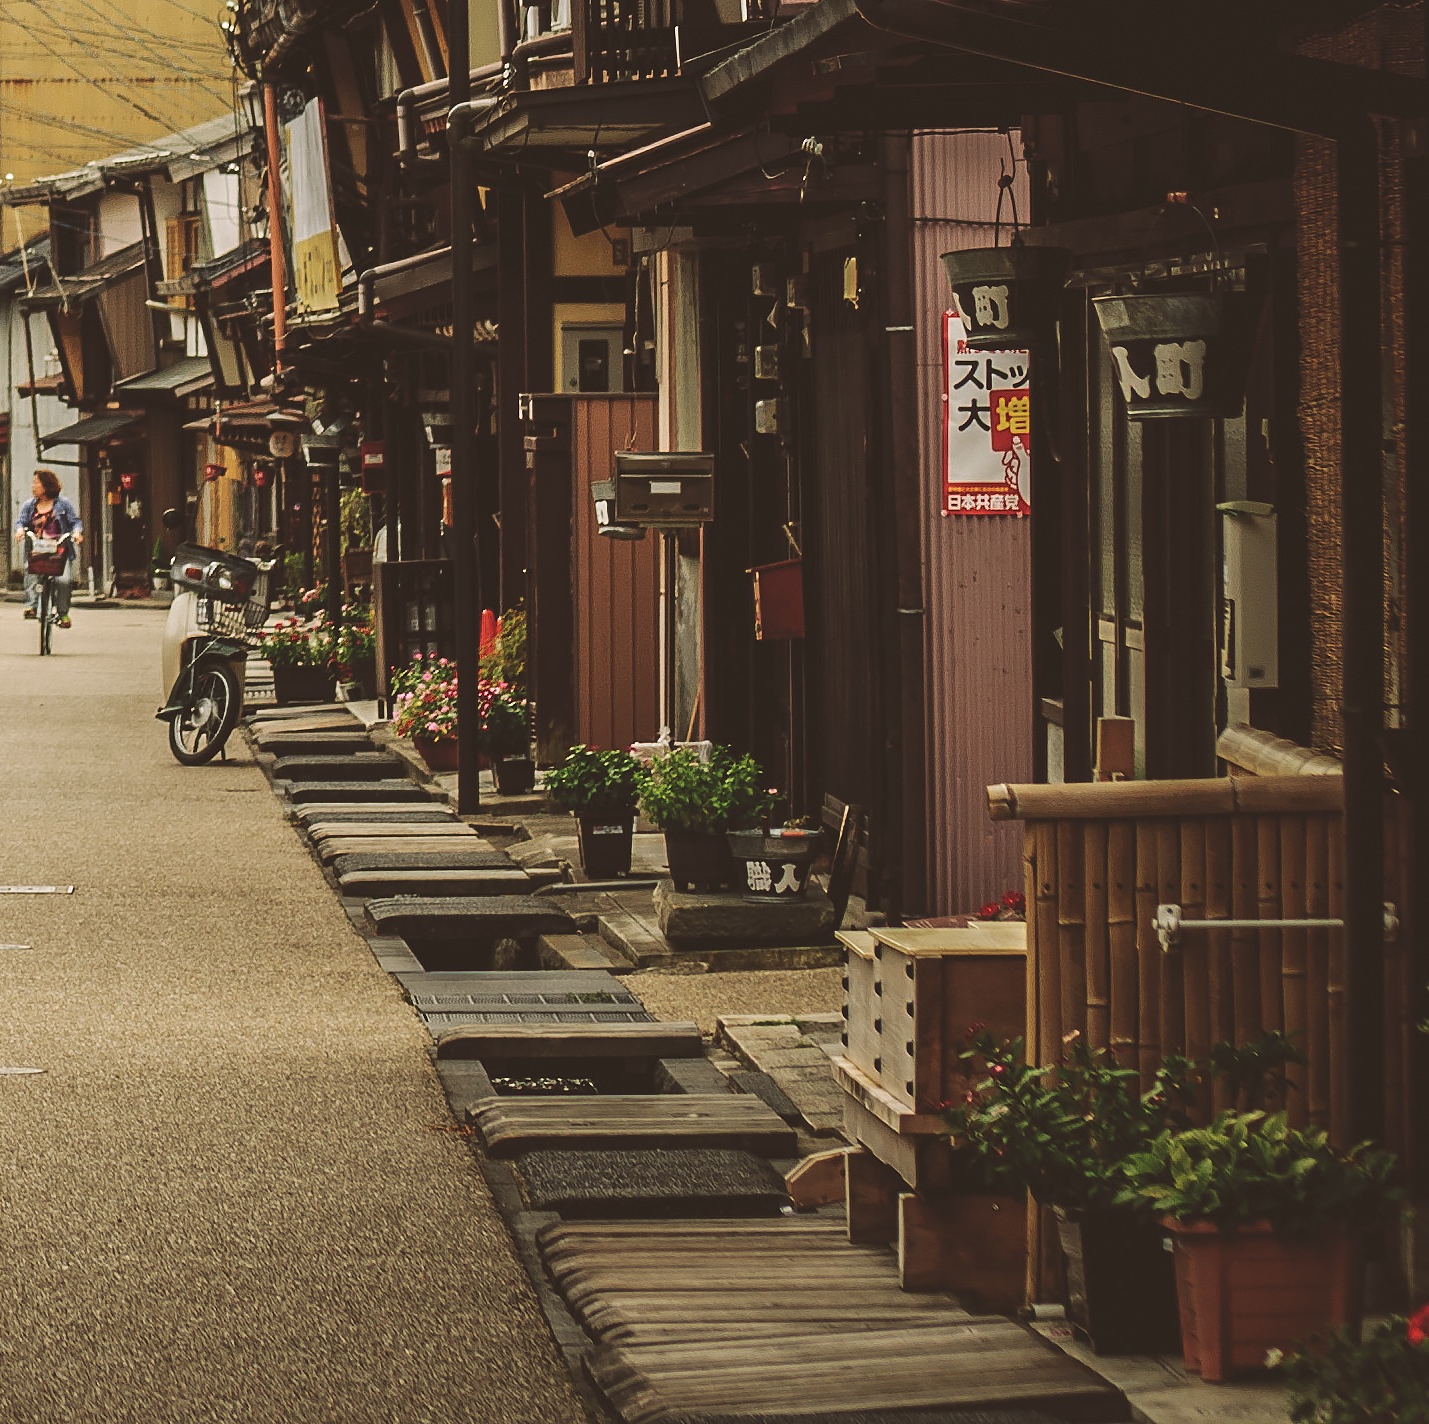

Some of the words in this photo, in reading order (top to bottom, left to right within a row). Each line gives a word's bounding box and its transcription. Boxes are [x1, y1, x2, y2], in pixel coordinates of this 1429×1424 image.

[948, 495, 1019, 511] 日本共産党
